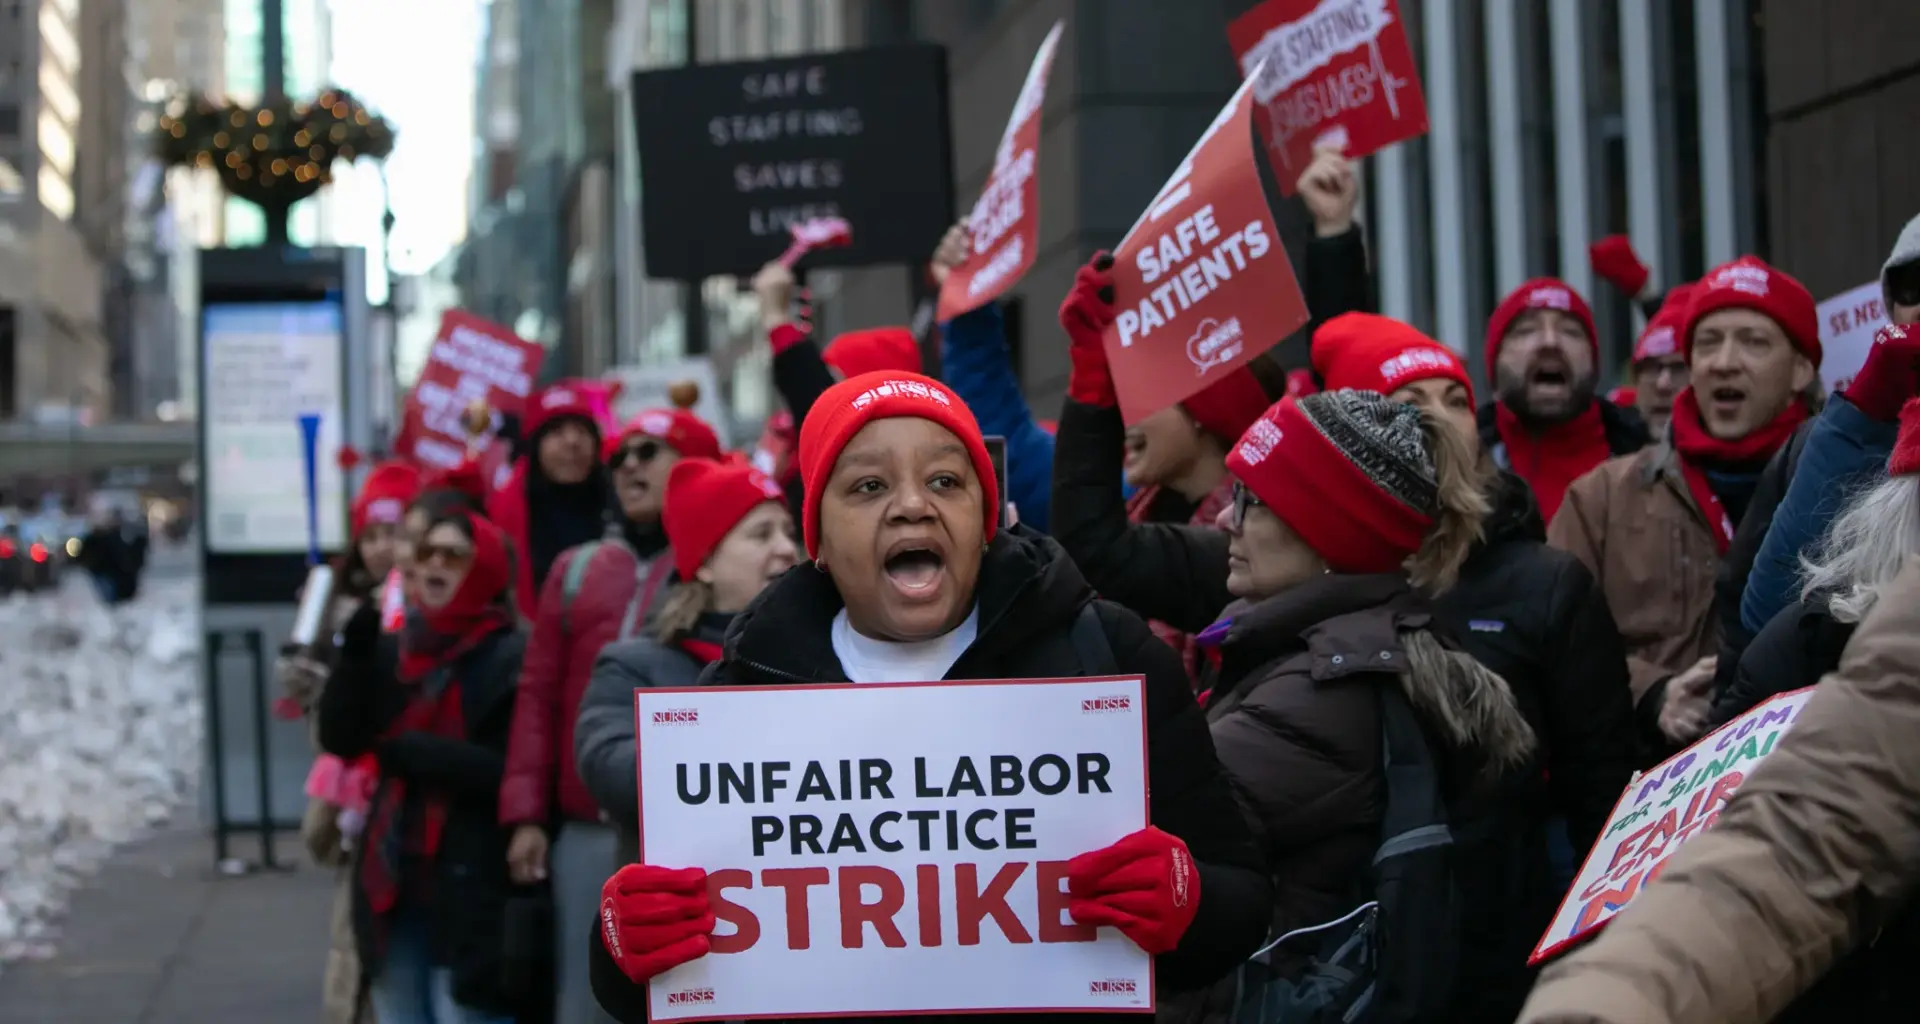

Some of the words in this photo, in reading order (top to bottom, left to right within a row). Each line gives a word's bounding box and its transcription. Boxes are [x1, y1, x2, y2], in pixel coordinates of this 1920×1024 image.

[742, 65, 826, 101] SAFE
[708, 107, 864, 147] STAFFING
[733, 160, 843, 193] SAVES
[1136, 203, 1221, 283] SAFE
[1115, 220, 1270, 347] PATIENTS
[652, 711, 699, 723] NURSES
[1082, 698, 1130, 711] NURSES
[1634, 752, 1698, 807] NO
[1715, 704, 1807, 752] COM
[676, 757, 894, 806] UNFAIR
[914, 752, 1113, 799] LABOR
[751, 808, 1038, 857] PRACTICE
[1605, 802, 1652, 840] FOR
[1606, 771, 1744, 873] FAIR
[706, 860, 1097, 954] STRIKE
[667, 990, 715, 1004] NURSES
[1089, 981, 1137, 993] NURSES
